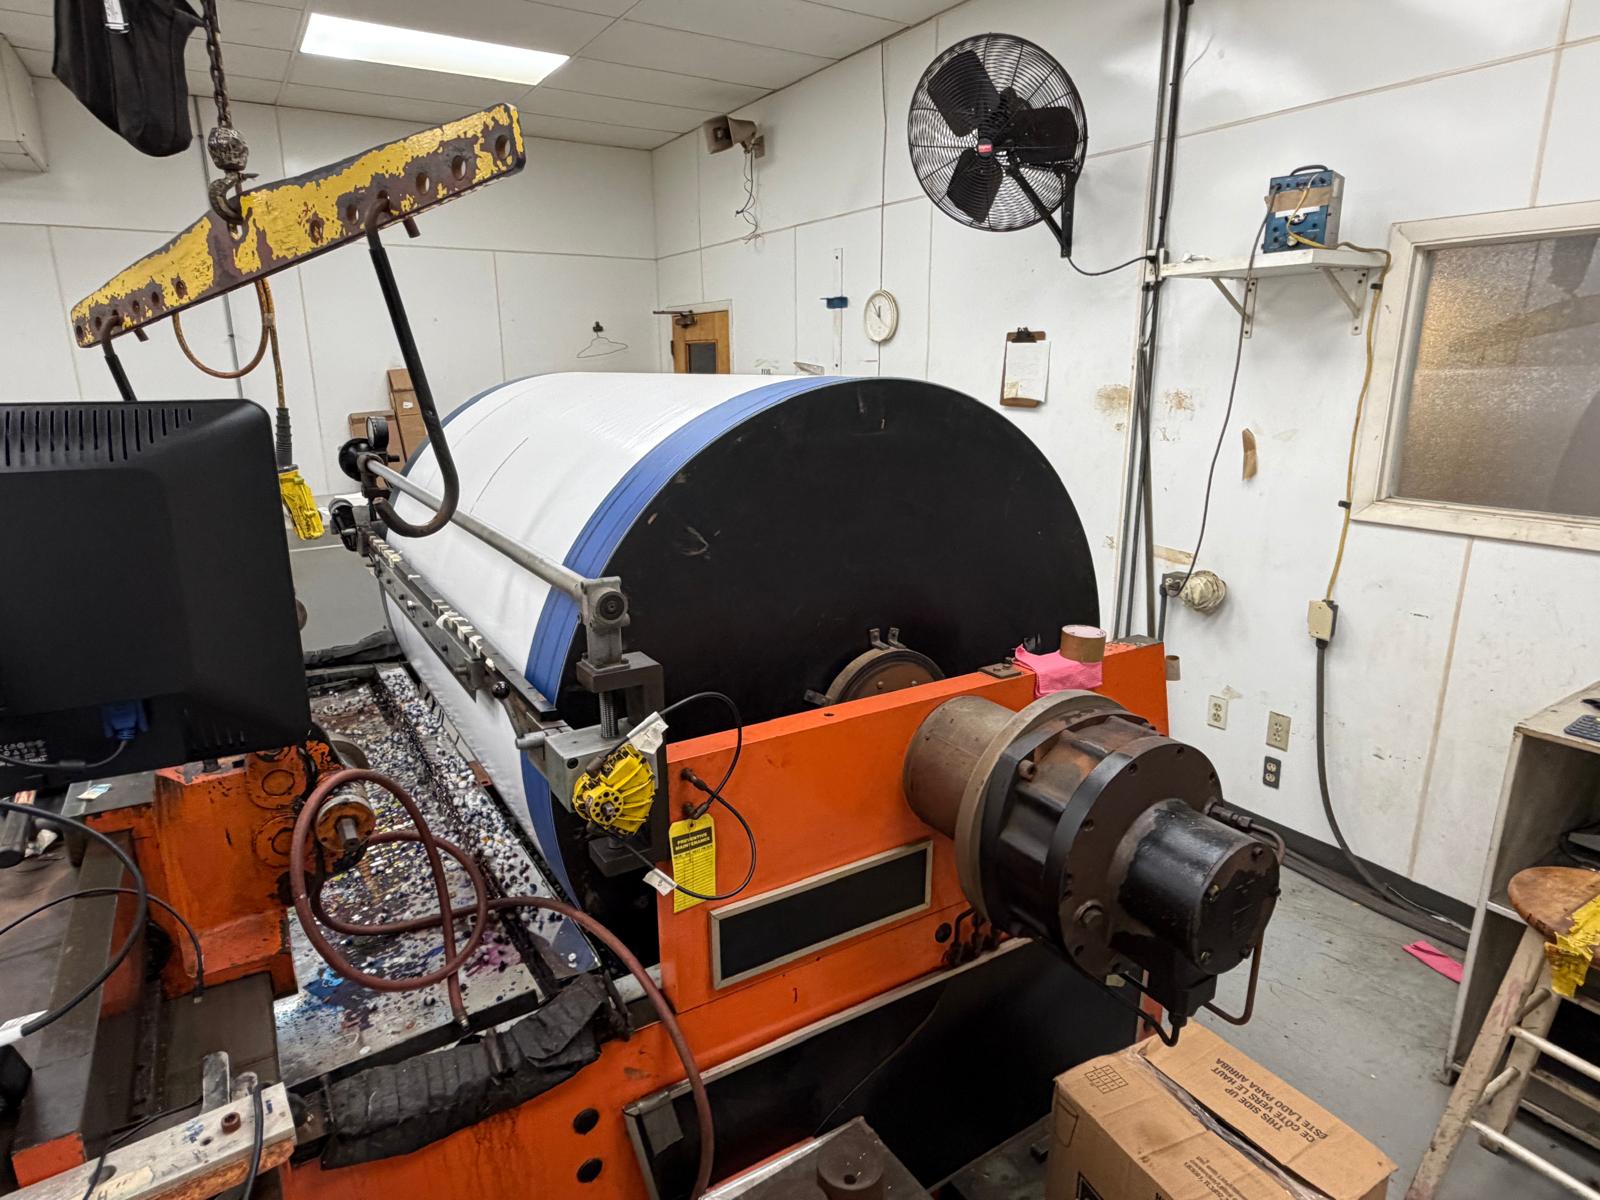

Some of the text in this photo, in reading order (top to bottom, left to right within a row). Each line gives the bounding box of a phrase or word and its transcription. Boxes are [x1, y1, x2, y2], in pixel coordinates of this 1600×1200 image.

[1210, 1067, 1237, 1086] HAUT
[1215, 1057, 1250, 1083] ARRIBA
[1236, 1083, 1250, 1095] LE
[1249, 1081, 1275, 1102] PARA
[1224, 1087, 1284, 1131] THIS SIDE UP
[1248, 1093, 1273, 1113] VERS
[1275, 1100, 1302, 1121] LADO
[1300, 1130, 1316, 1143] CE
